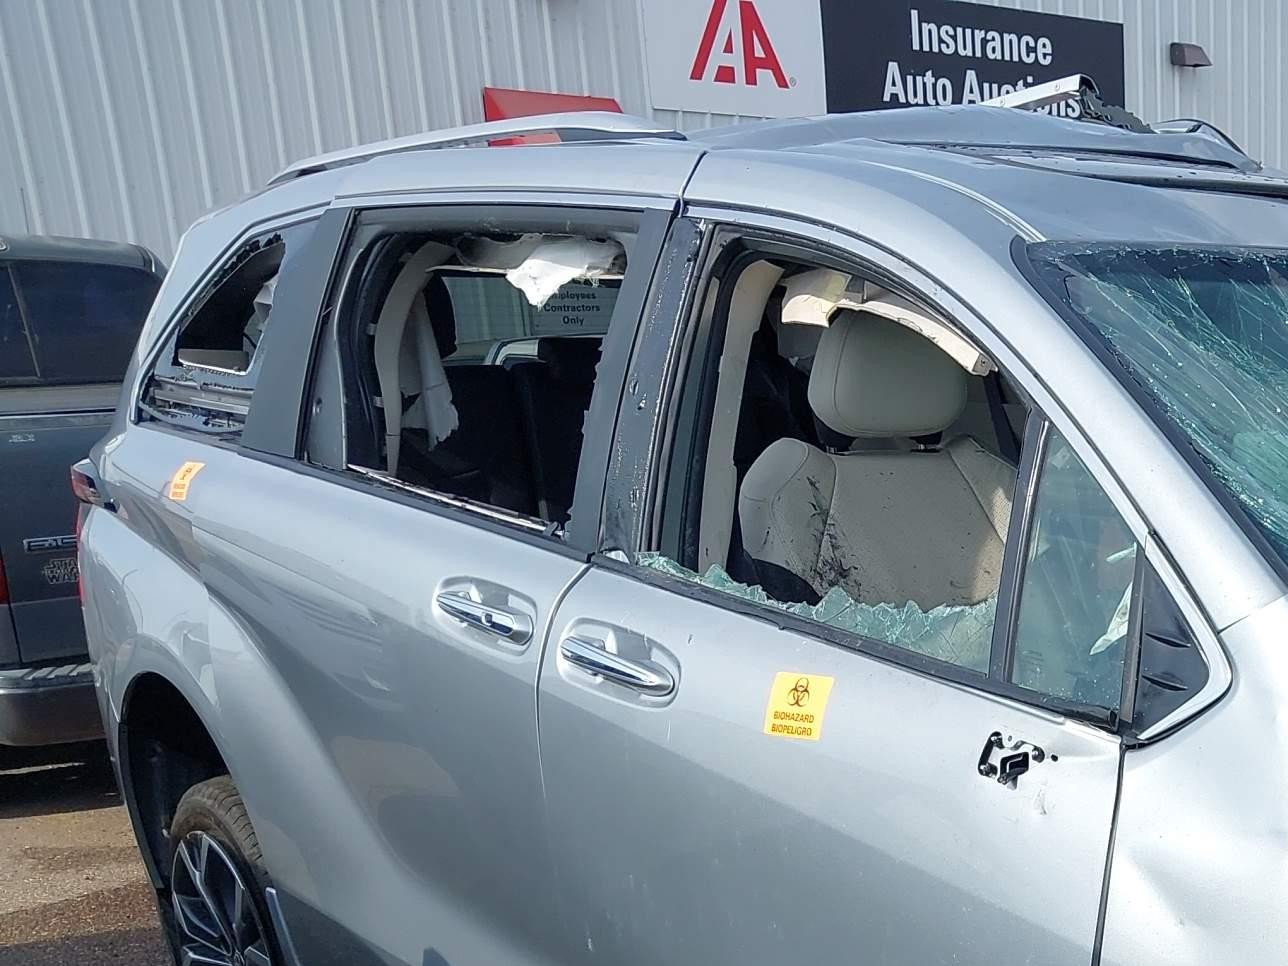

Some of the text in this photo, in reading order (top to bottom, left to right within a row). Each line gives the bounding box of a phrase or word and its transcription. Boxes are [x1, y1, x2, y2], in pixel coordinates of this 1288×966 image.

[910, 9, 1053, 65] Insurance
[882, 61, 953, 106] Auto
[551, 291, 597, 301] mployees
[543, 303, 600, 312] Contractors
[562, 316, 584, 326] Only
[773, 711, 814, 723] BIOHAZARD
[771, 723, 812, 736] BIOPELIGRO
